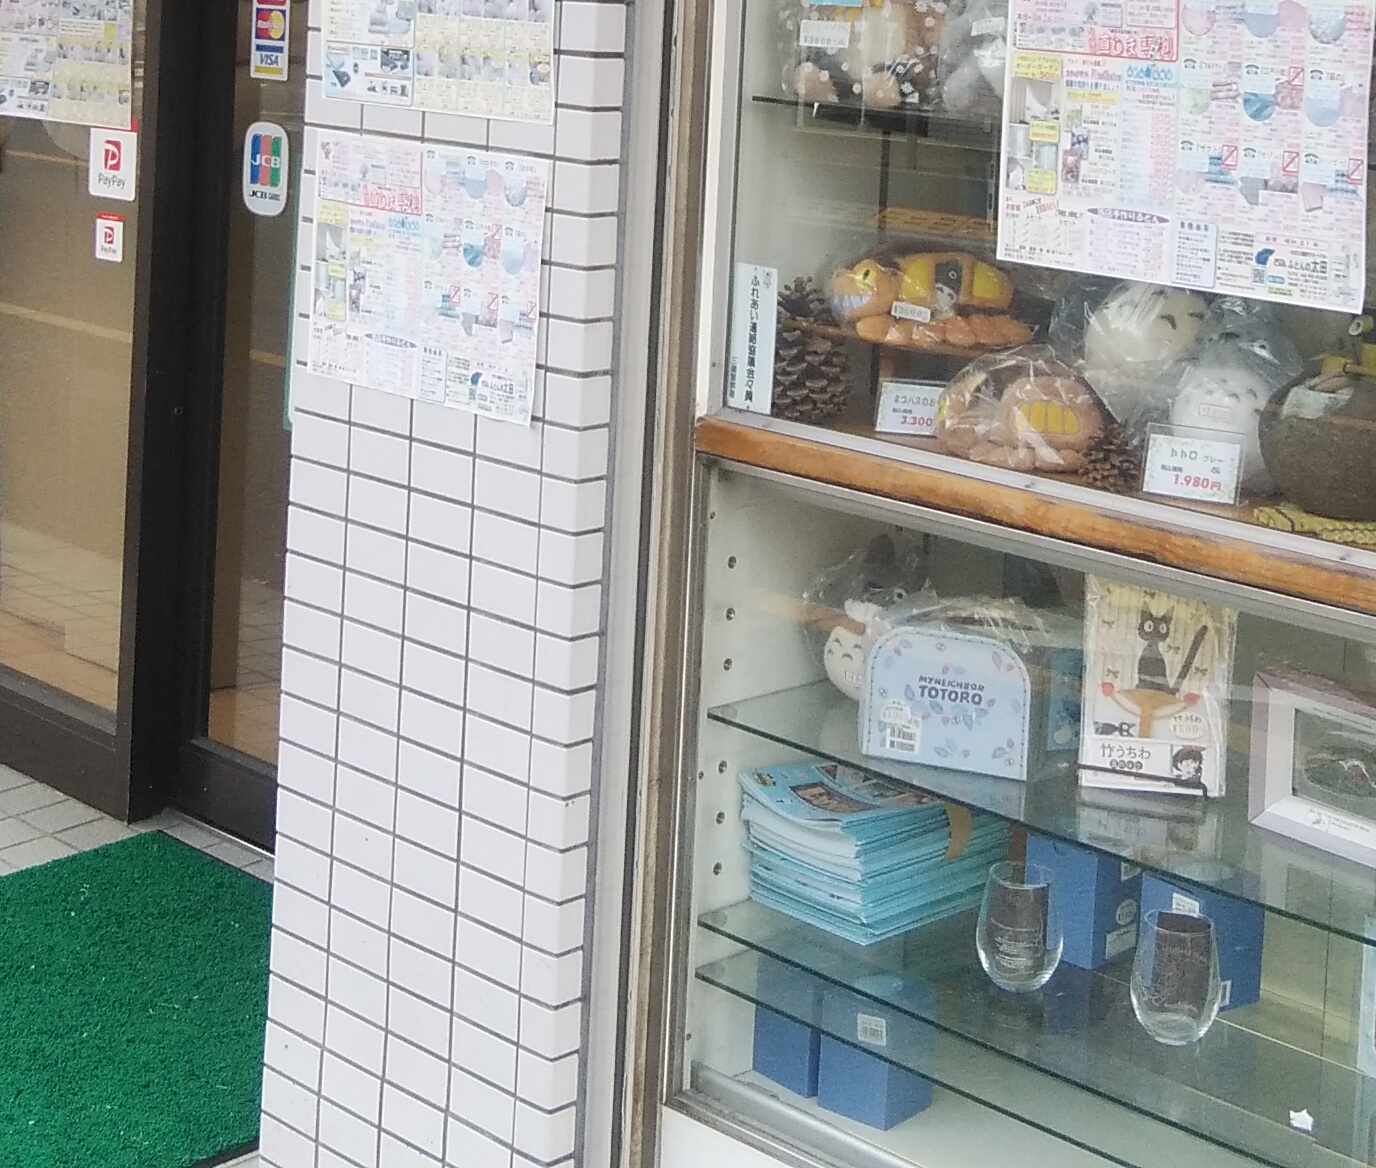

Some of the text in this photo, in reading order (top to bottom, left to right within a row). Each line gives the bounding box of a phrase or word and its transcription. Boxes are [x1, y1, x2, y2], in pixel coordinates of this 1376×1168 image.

[259, 53, 279, 66] VISA
[98, 172, 126, 189] PayPay
[249, 190, 268, 200] JCB
[1170, 448, 1224, 464] トトロ グレー
[1173, 474, 1222, 491] 1.980円
[919, 685, 983, 705] TOTORO
[1101, 743, 1151, 760] 竹うちわ
